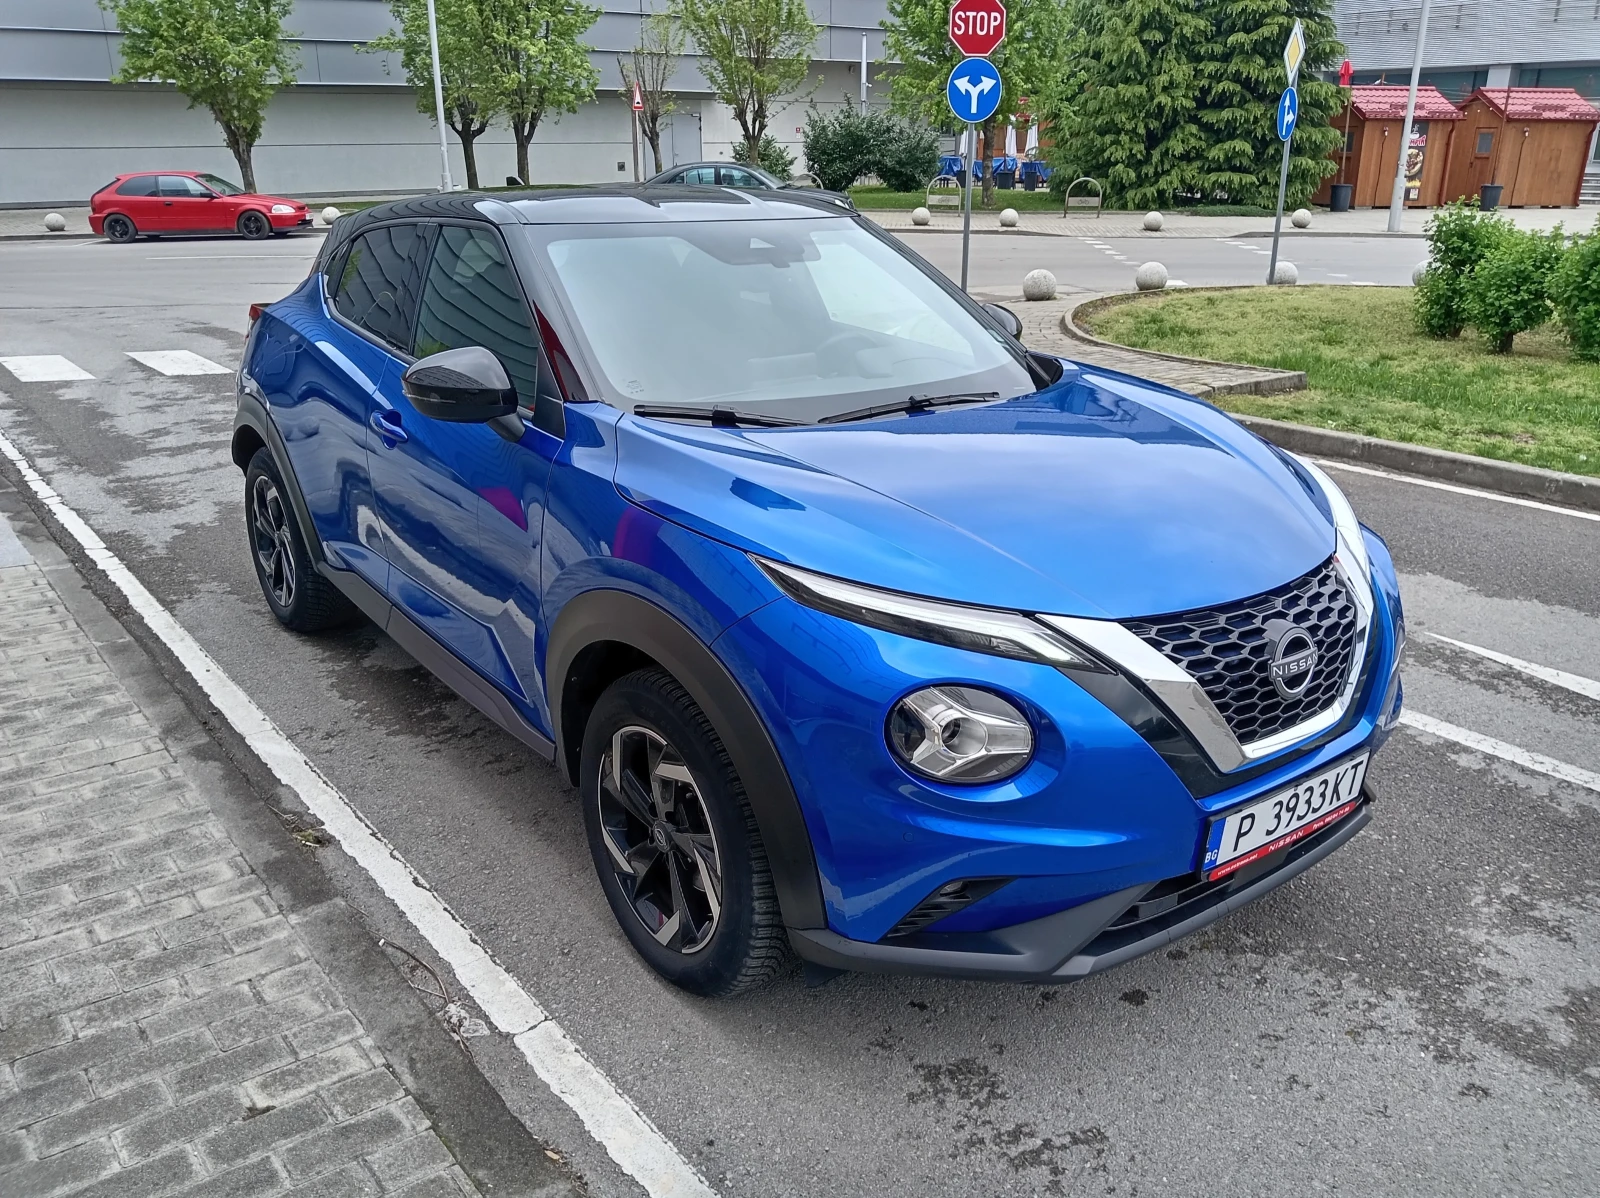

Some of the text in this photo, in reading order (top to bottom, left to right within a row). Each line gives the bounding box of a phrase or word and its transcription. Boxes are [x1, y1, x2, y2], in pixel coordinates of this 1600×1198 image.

[953, 11, 1002, 36] STOP
[1272, 651, 1318, 677] NISSAN
[1232, 812, 1256, 852] P
[1265, 759, 1364, 837] 3933KT
[1268, 829, 1304, 852] NISSAN
[1204, 849, 1218, 863] BG
